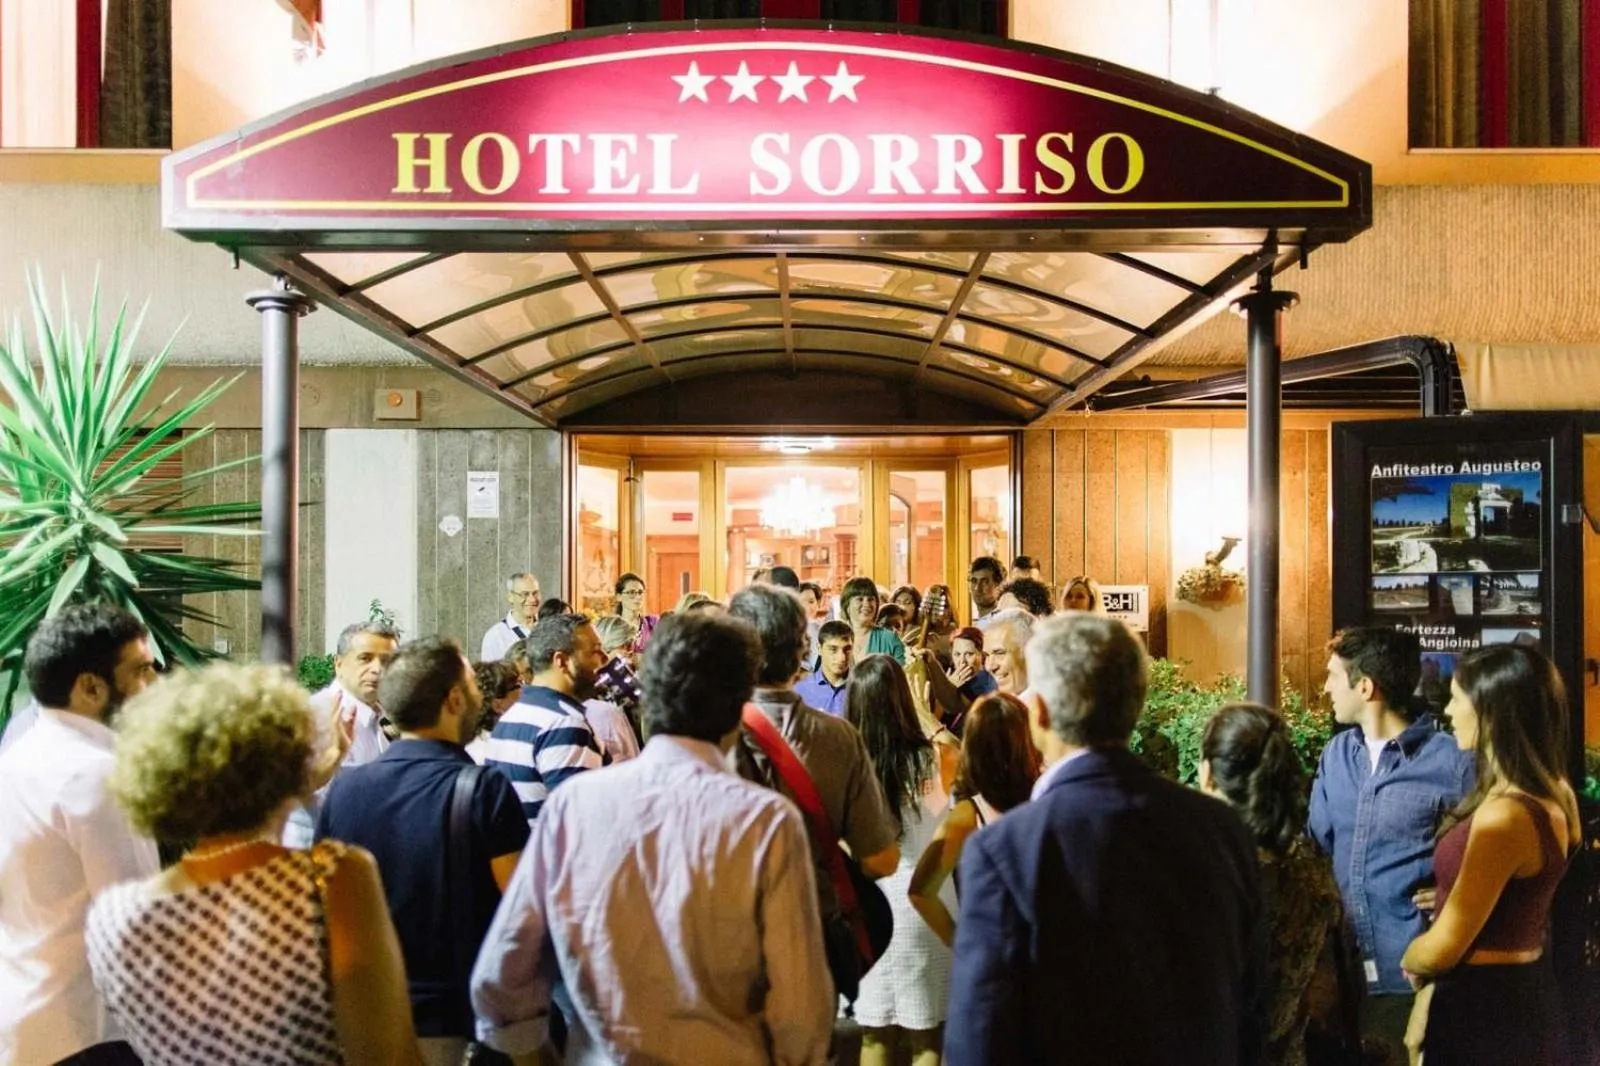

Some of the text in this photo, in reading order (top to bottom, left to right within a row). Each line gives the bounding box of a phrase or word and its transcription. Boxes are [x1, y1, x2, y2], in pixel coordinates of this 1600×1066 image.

[391, 131, 1145, 196] HOTEL SORRISO
[1371, 460, 1542, 477] Anfiteatro Augusteo
